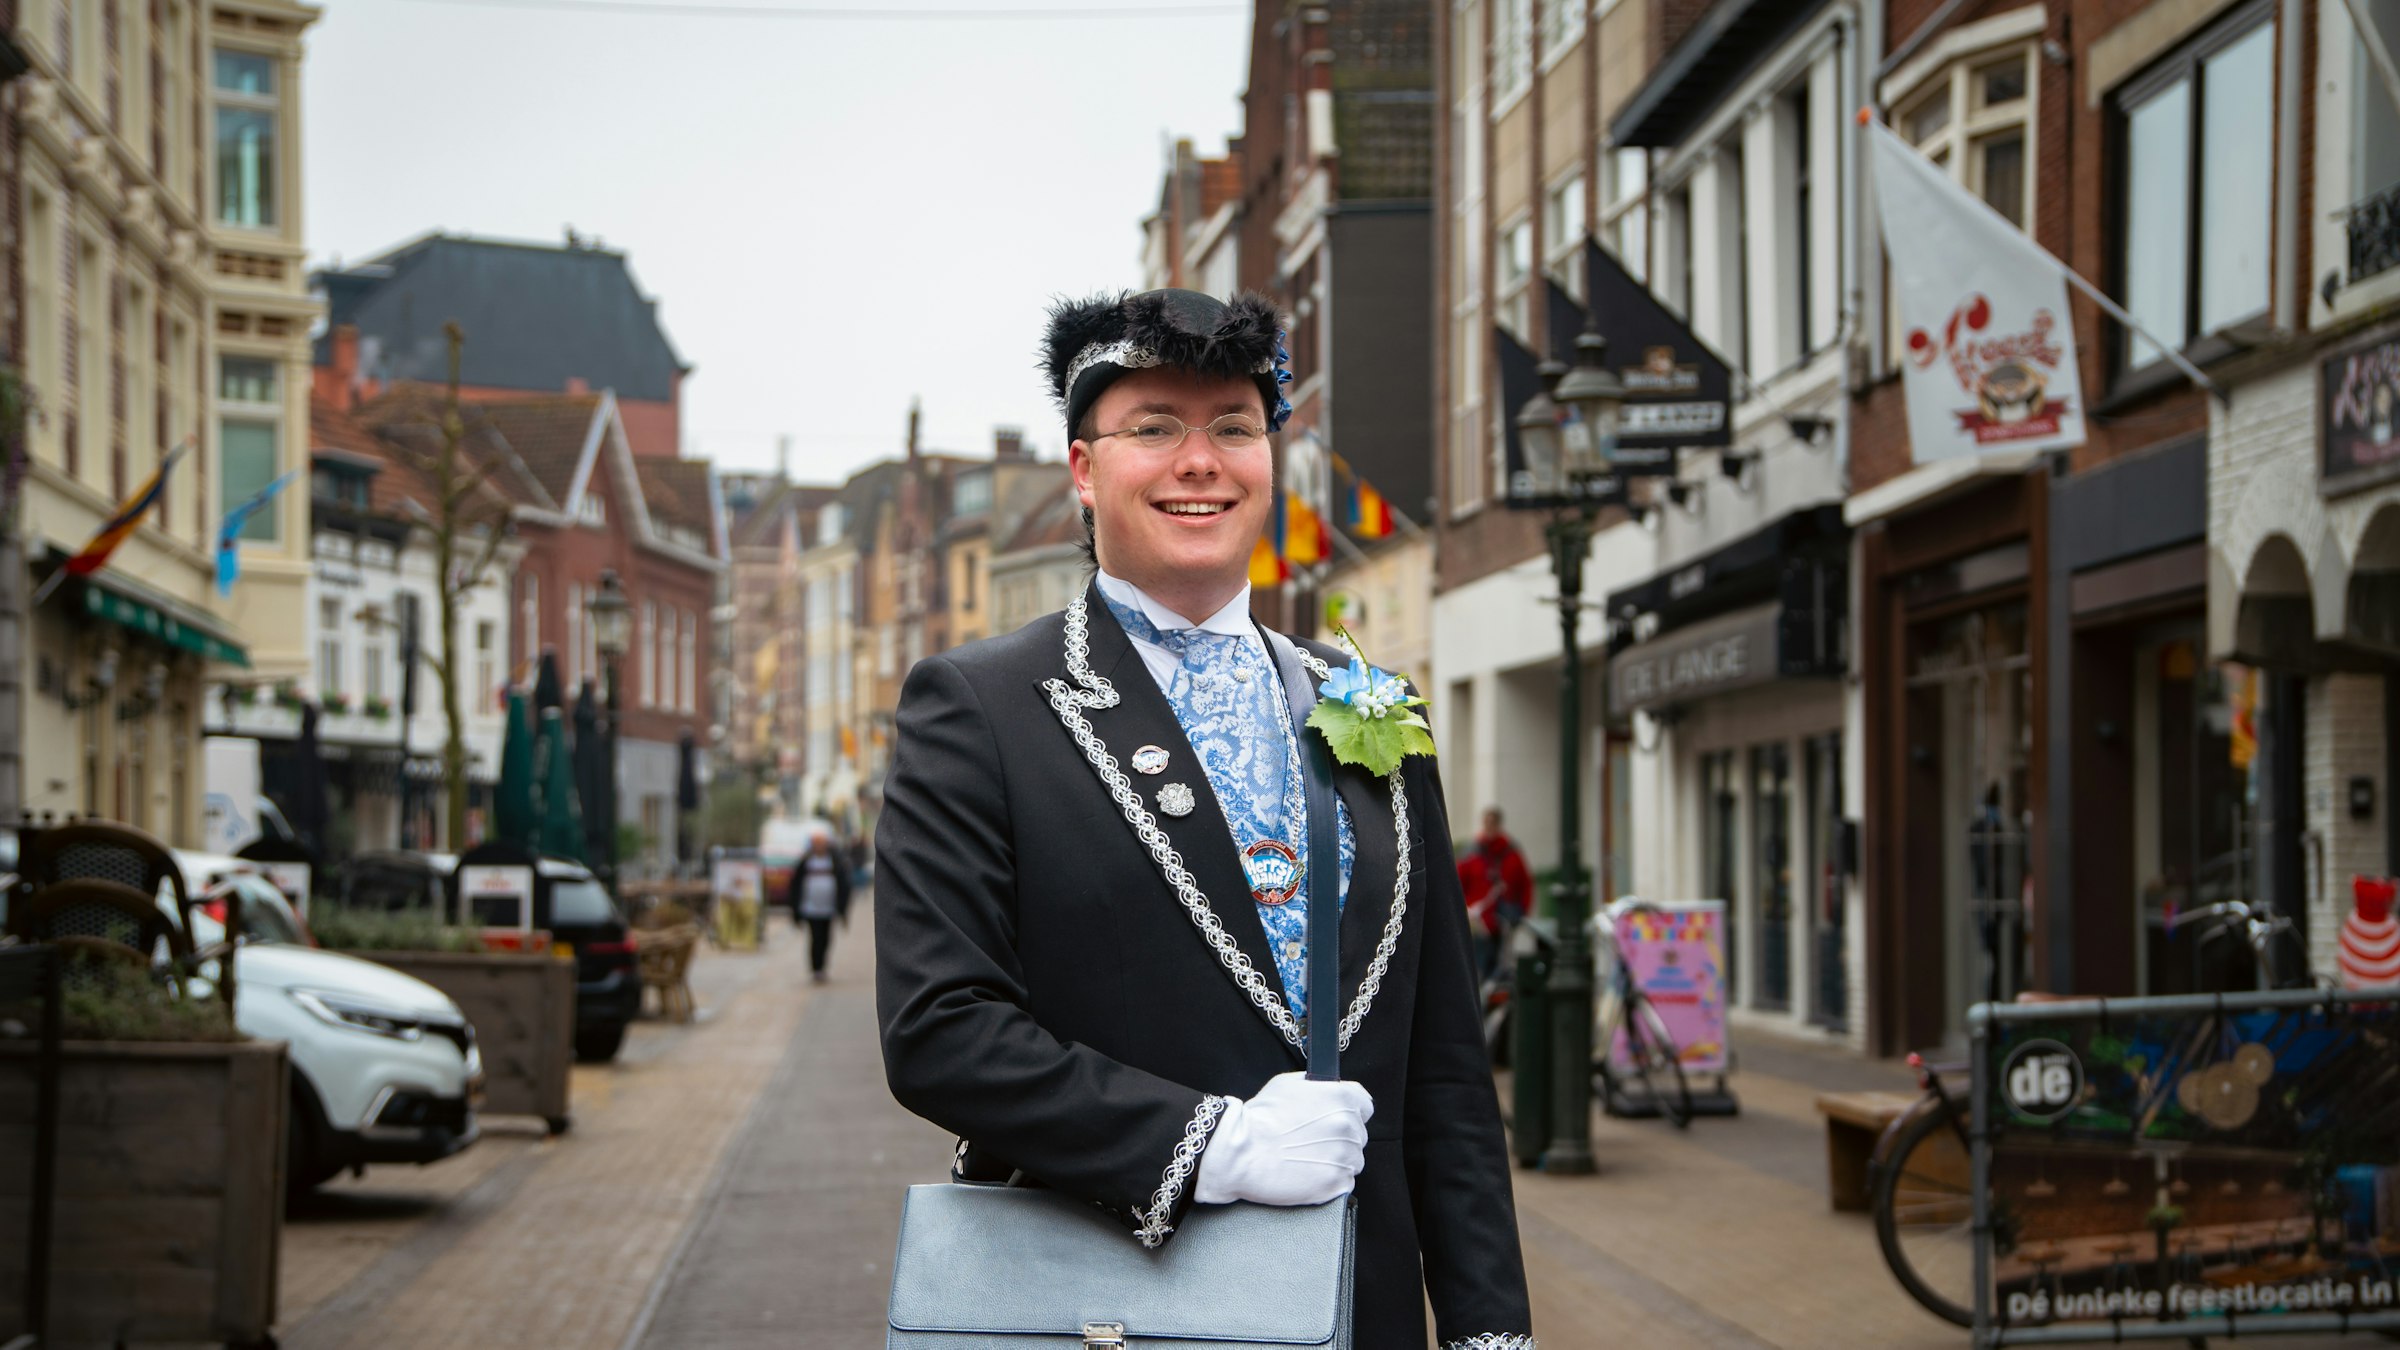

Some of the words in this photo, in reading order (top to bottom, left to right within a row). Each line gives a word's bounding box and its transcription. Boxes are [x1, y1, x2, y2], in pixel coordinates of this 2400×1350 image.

[1624, 661, 1656, 699] DE
[1659, 634, 1748, 693] LANGE
[2007, 1289, 2049, 1320] Dé
[2054, 1286, 2162, 1318] unieke
[2168, 1277, 2354, 1315] feestlocatie
[2360, 1276, 2392, 1306] in
